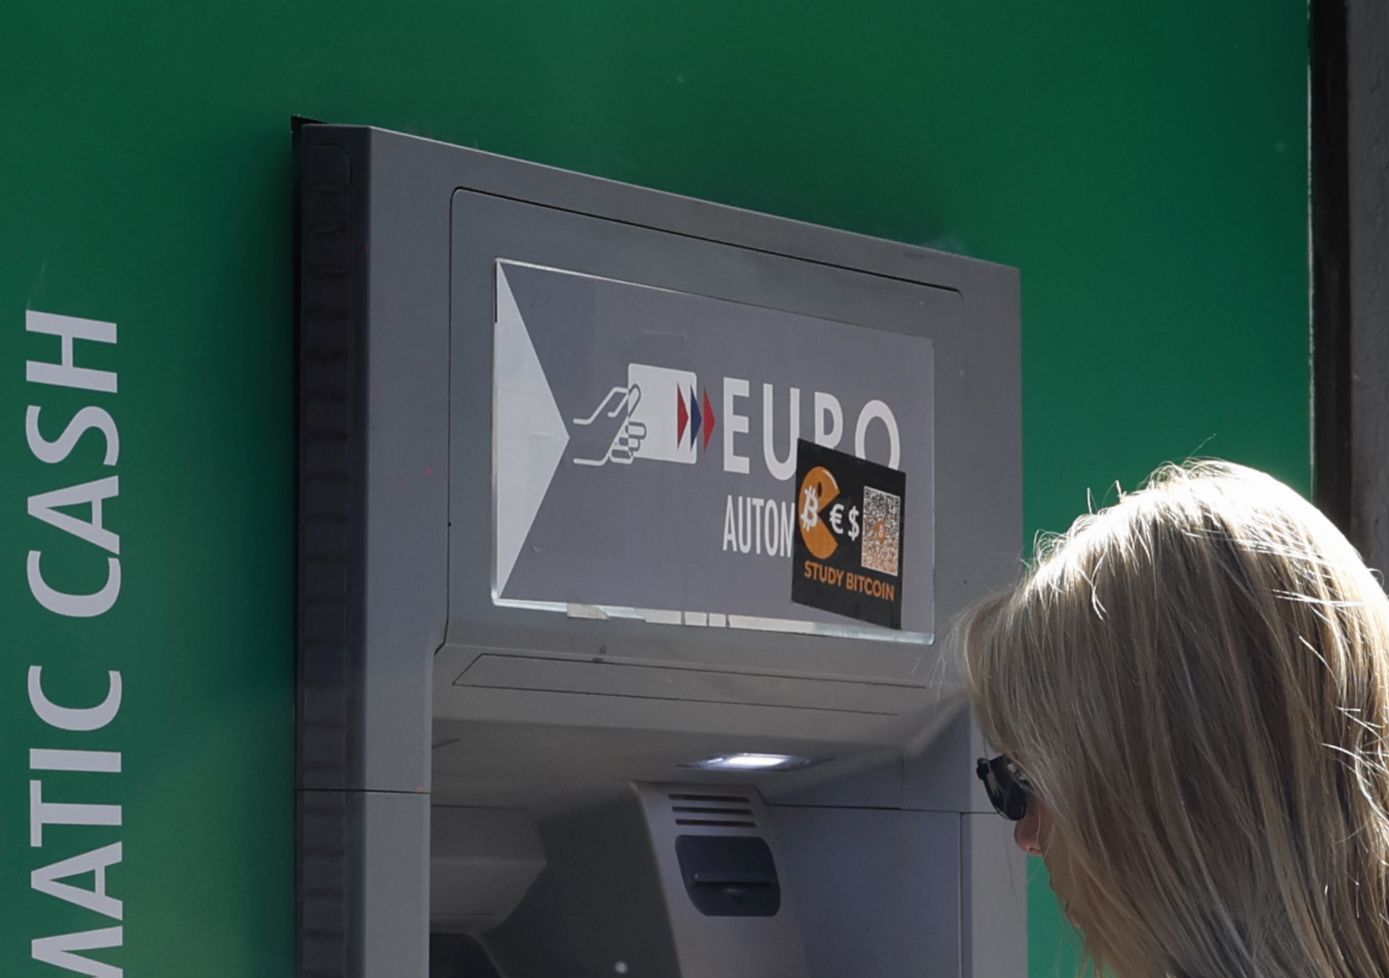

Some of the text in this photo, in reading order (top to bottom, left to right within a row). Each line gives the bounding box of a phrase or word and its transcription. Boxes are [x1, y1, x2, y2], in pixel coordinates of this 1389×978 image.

[25, 310, 121, 618] CASH
[722, 494, 796, 558] AUTOM
[803, 560, 896, 601] STUDY BITCOIN
